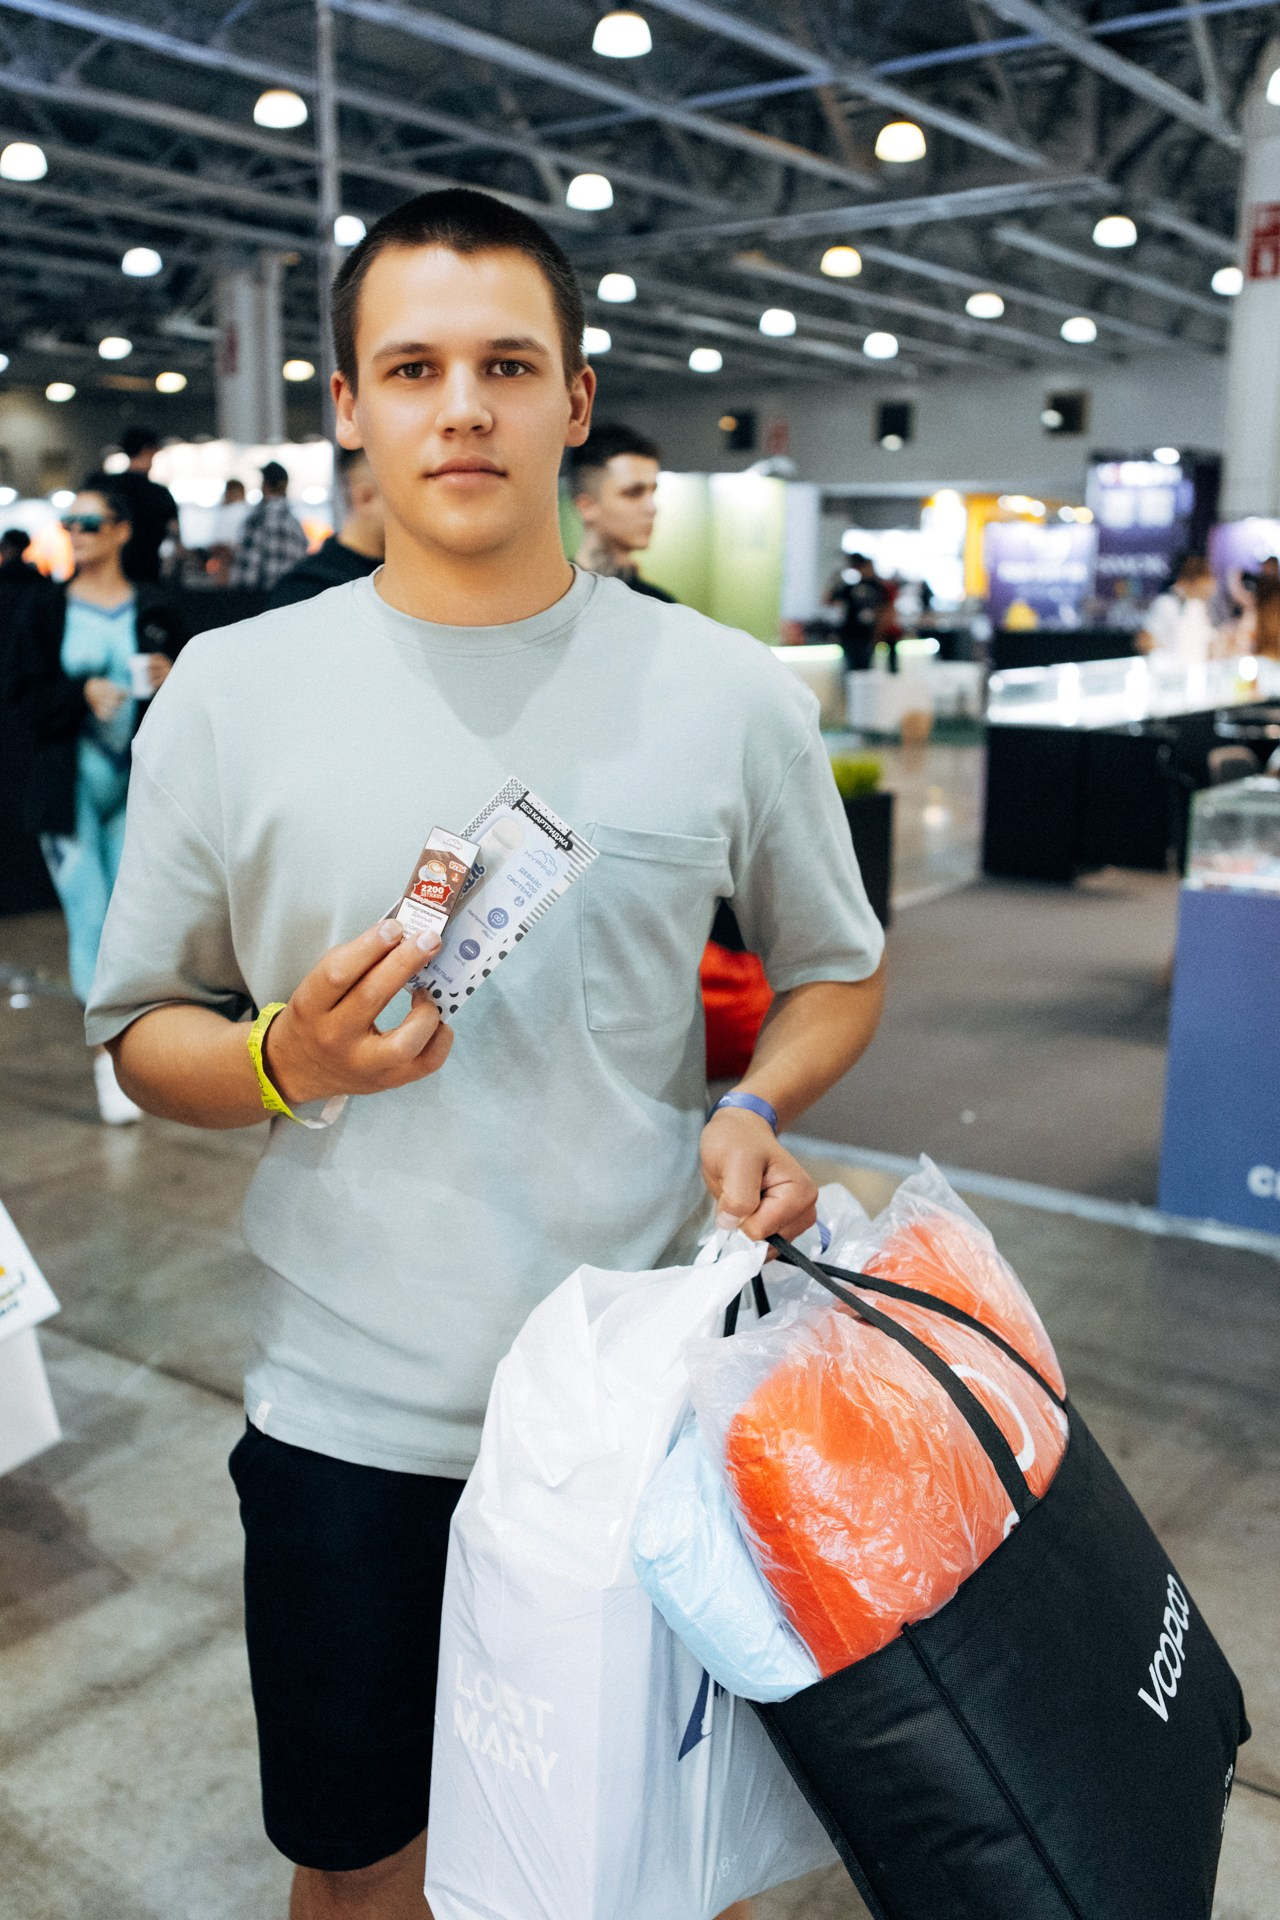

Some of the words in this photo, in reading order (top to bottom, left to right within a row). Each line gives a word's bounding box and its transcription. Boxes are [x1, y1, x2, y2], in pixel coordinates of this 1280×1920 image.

[520, 801, 533, 815] БЕЗ
[531, 811, 569, 849] КАРТРИДЖА
[421, 884, 444, 895] 2200
[506, 874, 533, 899] СИСТЕМА
[518, 867, 542, 889] ДЕВАЙС
[525, 881, 538, 894] POD
[432, 964, 454, 984] БЕЛЫЙ
[455, 1653, 555, 1740] LOST
[453, 1699, 559, 1790] MARY
